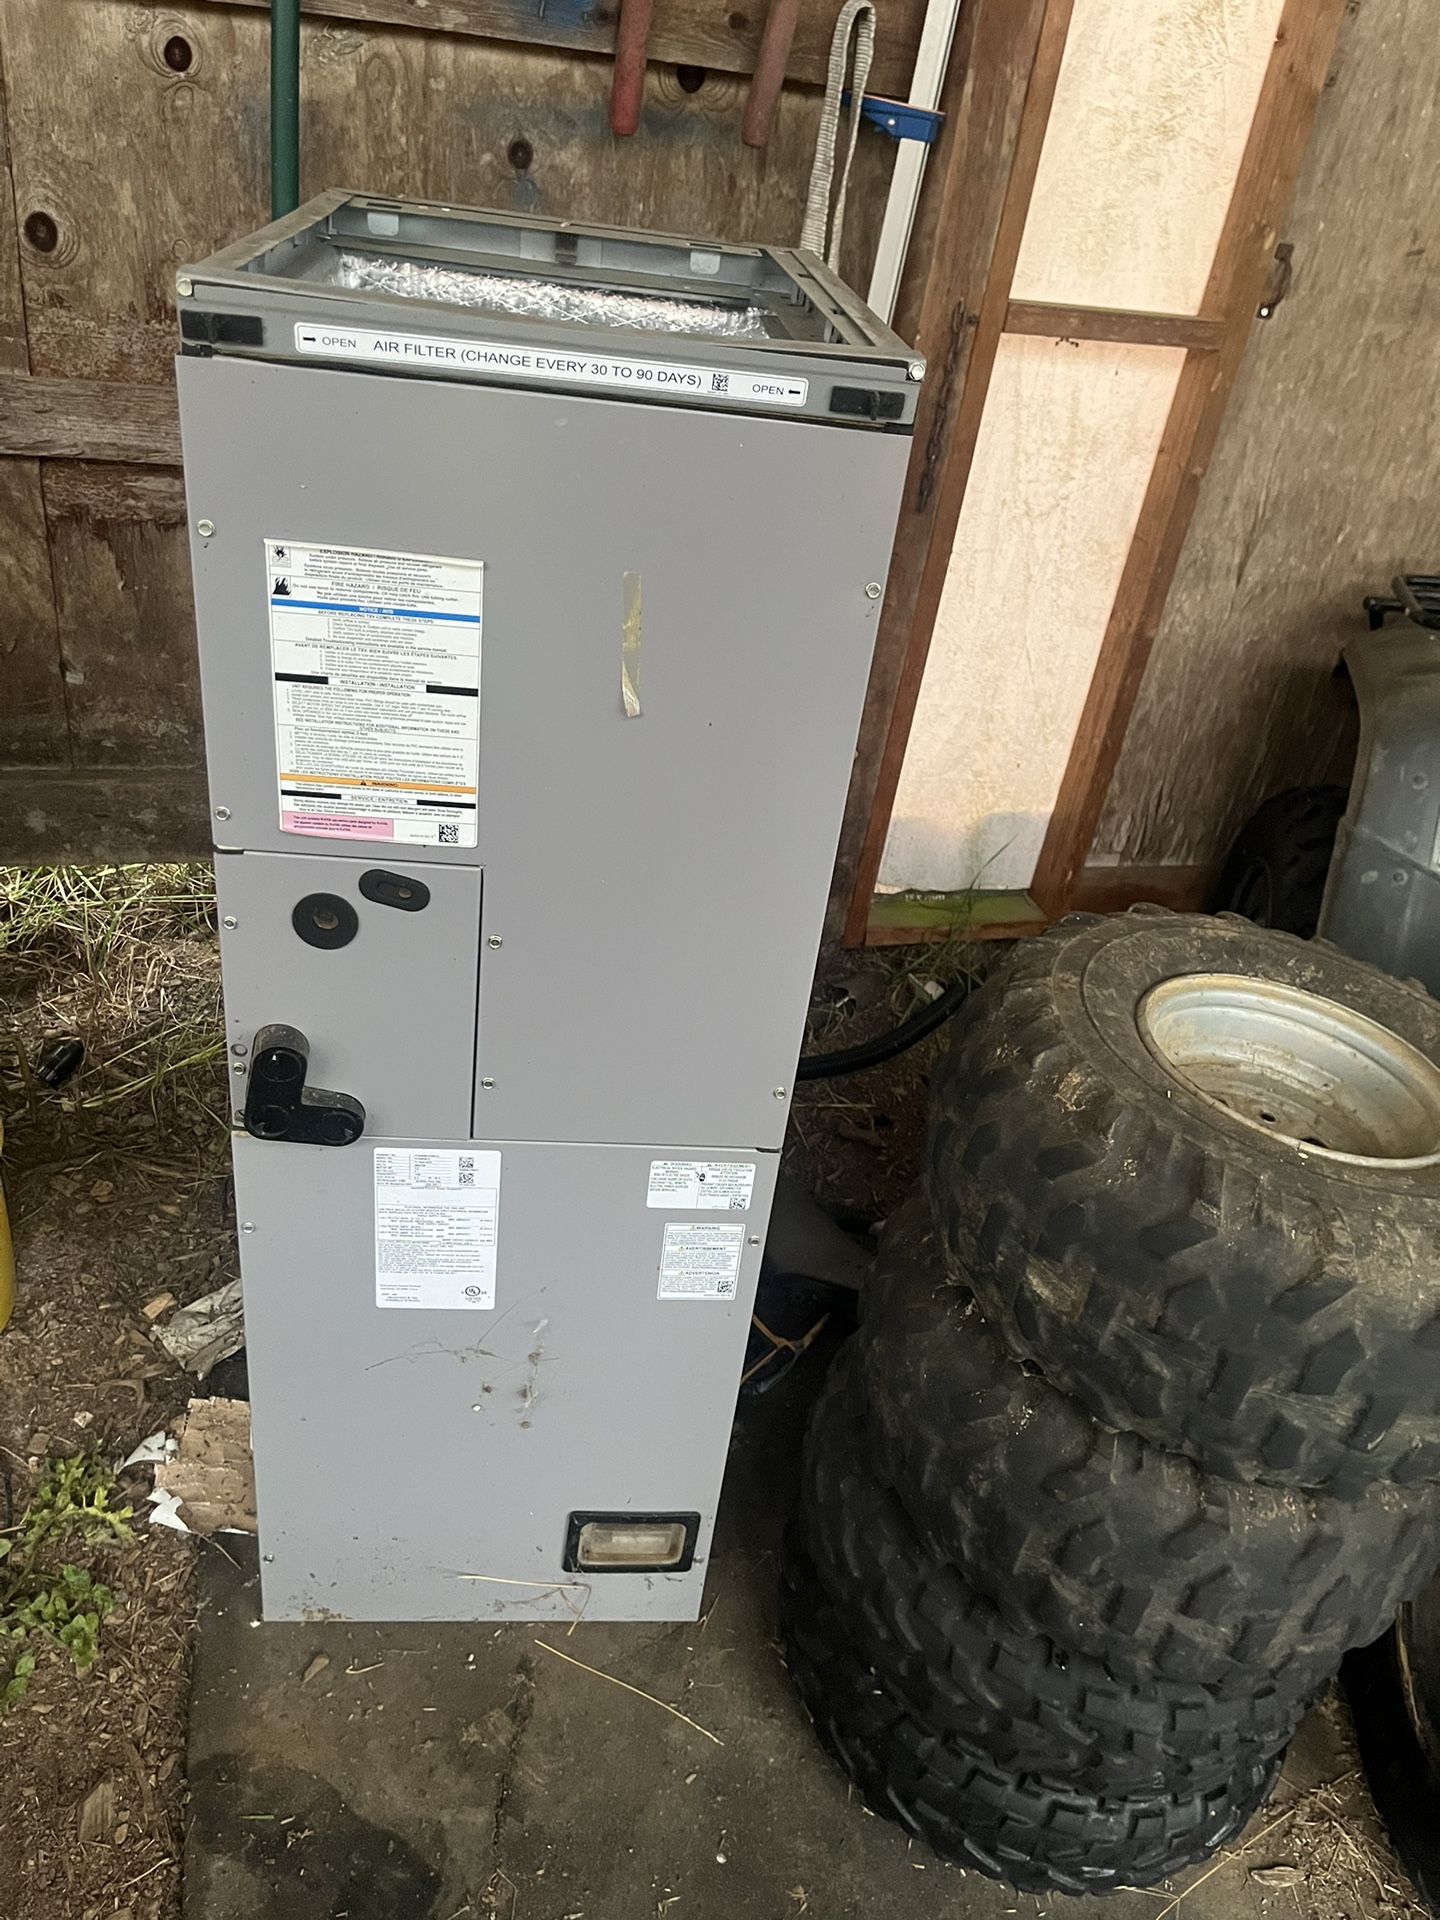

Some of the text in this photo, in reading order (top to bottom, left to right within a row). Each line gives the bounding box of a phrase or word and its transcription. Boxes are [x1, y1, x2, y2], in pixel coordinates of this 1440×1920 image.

[321, 336, 357, 348] OPEN
[373, 340, 702, 389] AIR FILTER (CHANGE EVERY 30 TO 90 DAYS)
[752, 384, 785, 396] OPEN
